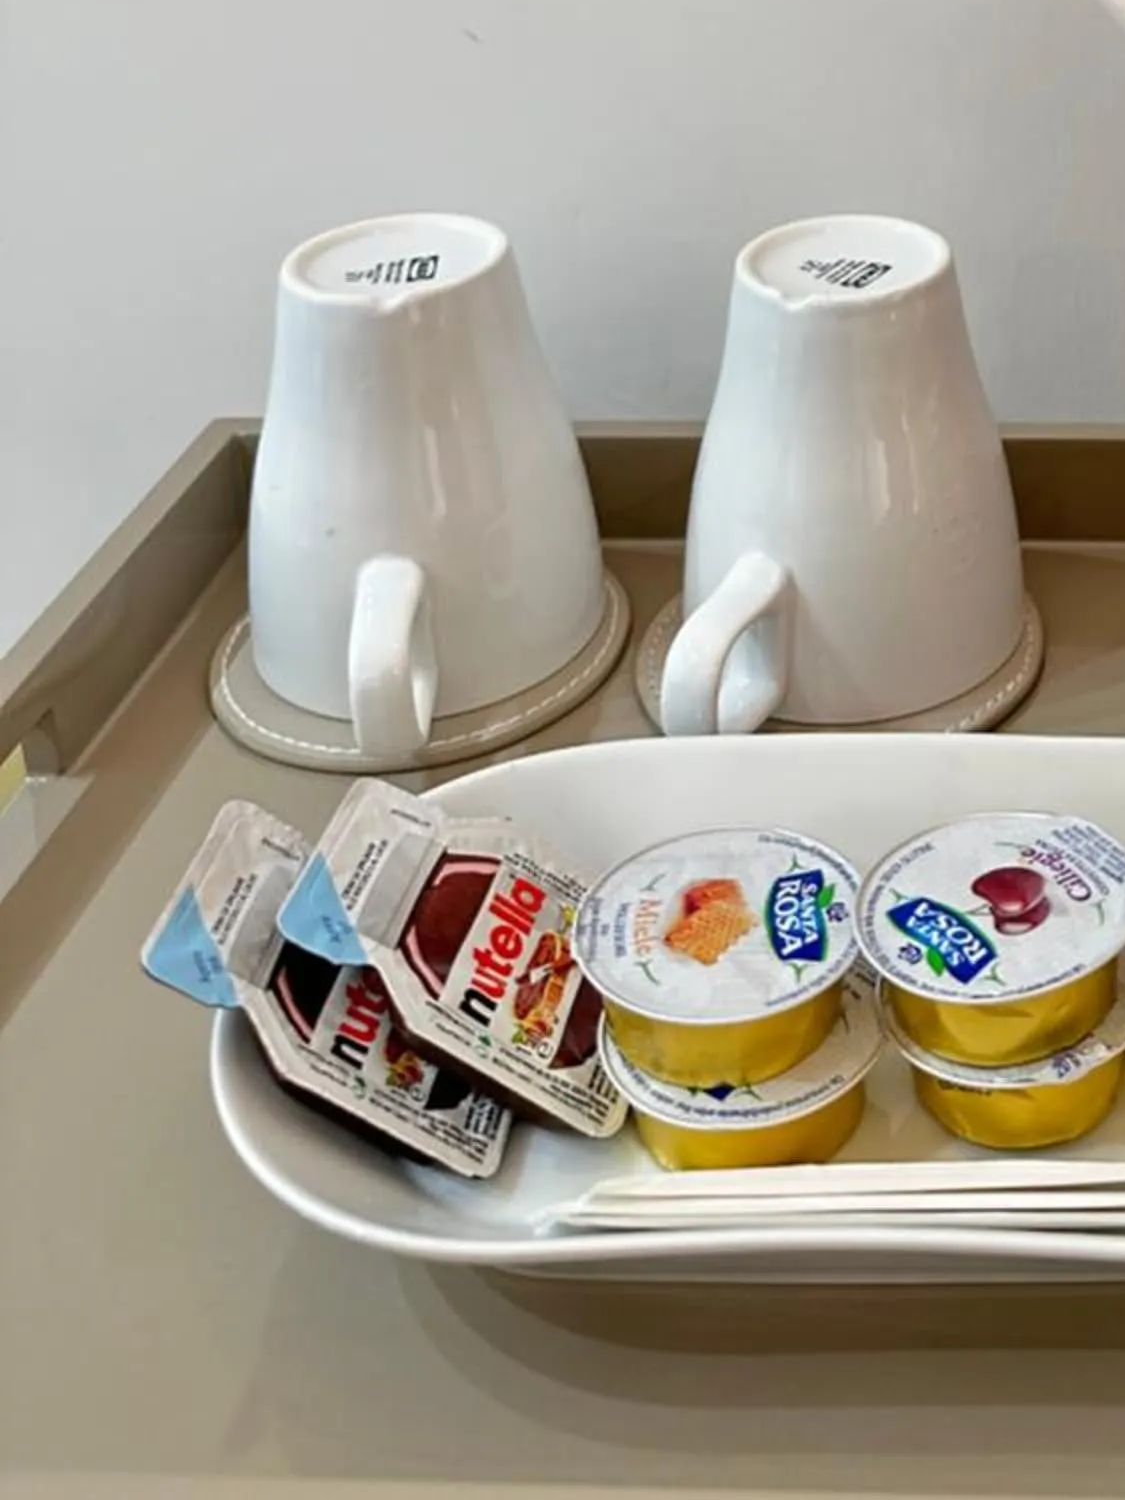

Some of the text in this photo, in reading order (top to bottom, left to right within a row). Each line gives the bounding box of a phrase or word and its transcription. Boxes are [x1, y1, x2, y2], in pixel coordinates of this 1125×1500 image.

[1021, 847, 1093, 902] Ciliegie
[633, 898, 662, 956] Miele
[773, 878, 803, 956] ROSA
[800, 880, 819, 945] SANTA
[905, 916, 966, 967] SANTA
[913, 901, 988, 965] ROSA
[459, 877, 548, 1028] nutella
